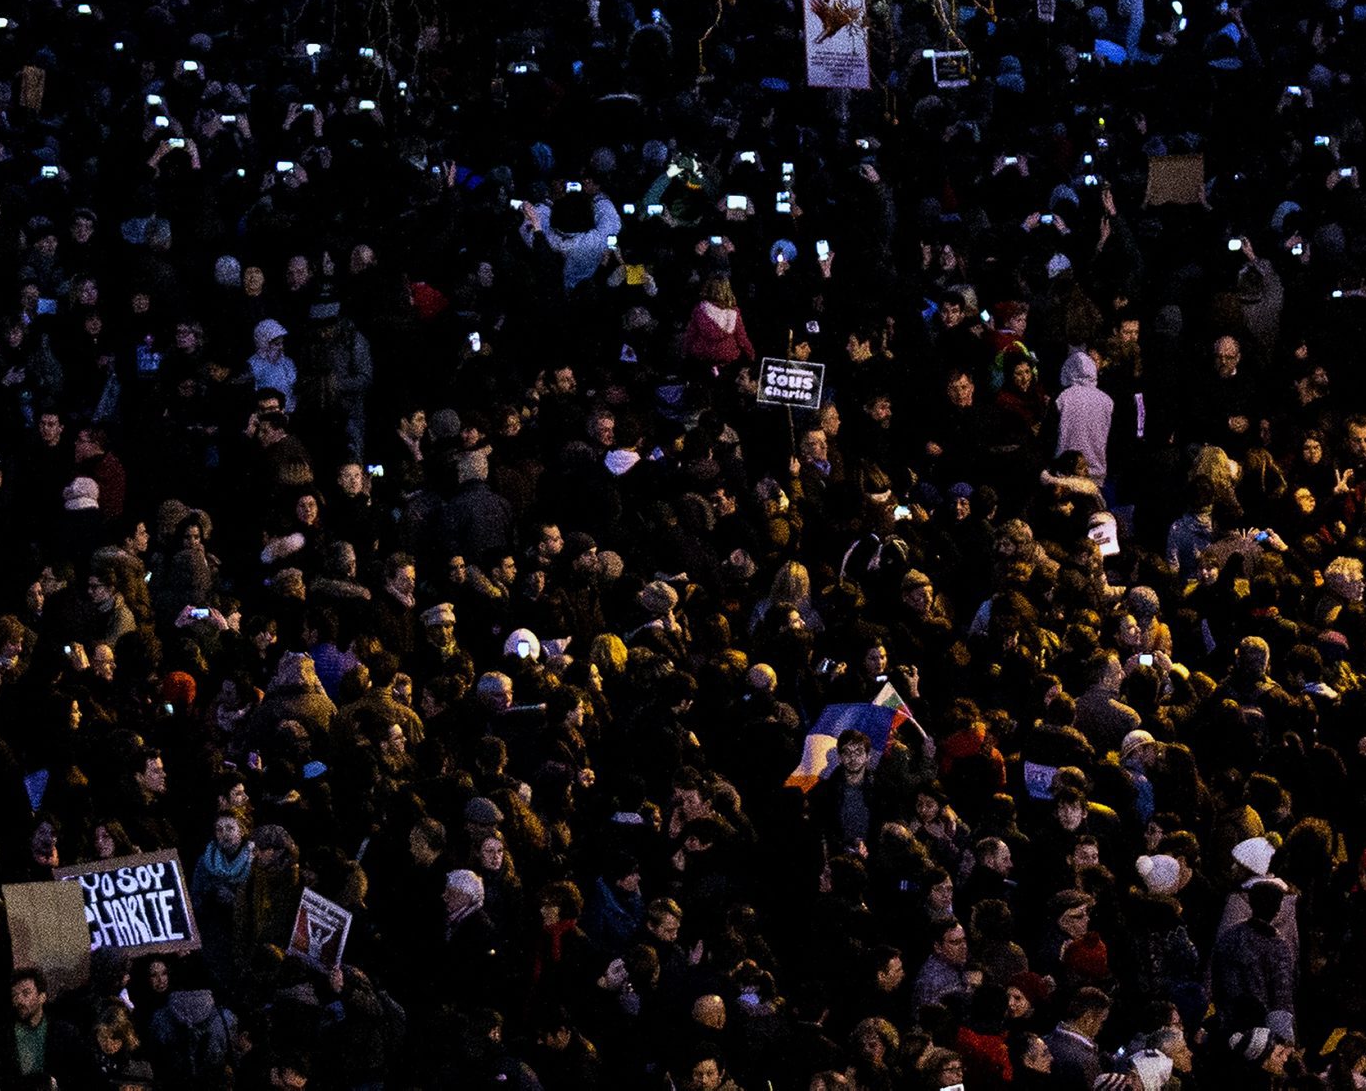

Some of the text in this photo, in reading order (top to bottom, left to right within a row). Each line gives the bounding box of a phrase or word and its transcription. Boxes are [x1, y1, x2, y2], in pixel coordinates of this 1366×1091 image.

[766, 371, 814, 390] tous
[79, 862, 165, 903] YO SOY
